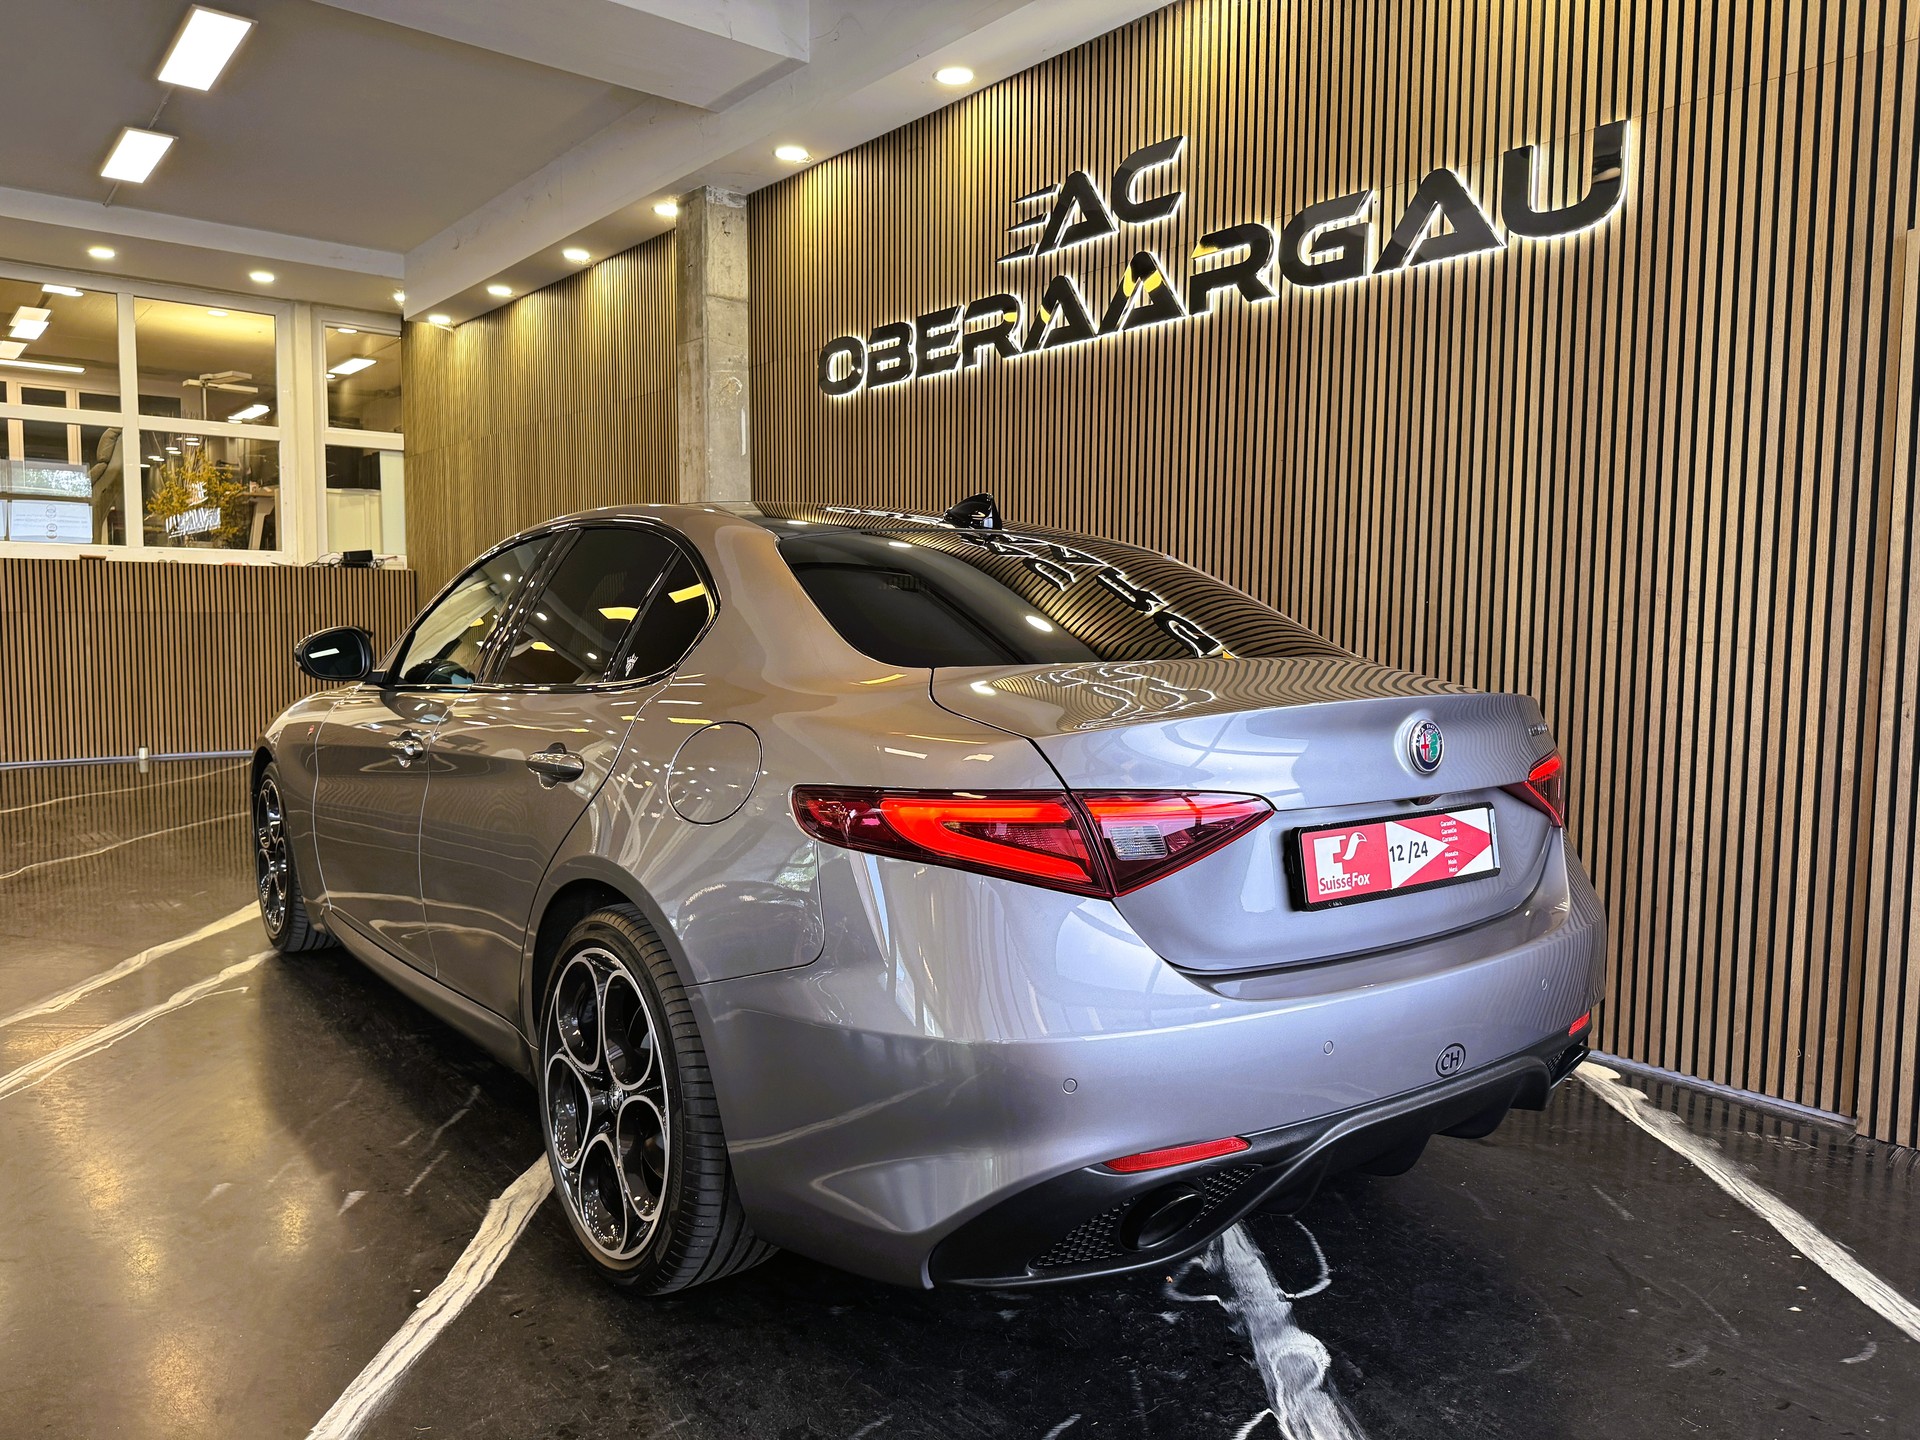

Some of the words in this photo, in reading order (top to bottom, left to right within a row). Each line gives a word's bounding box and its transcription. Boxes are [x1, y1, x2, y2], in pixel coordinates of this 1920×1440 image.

[817, 120, 1629, 398] OBERAARGAU
[1320, 872, 1370, 892] SuisseFox
[1441, 1050, 1460, 1071] CH
